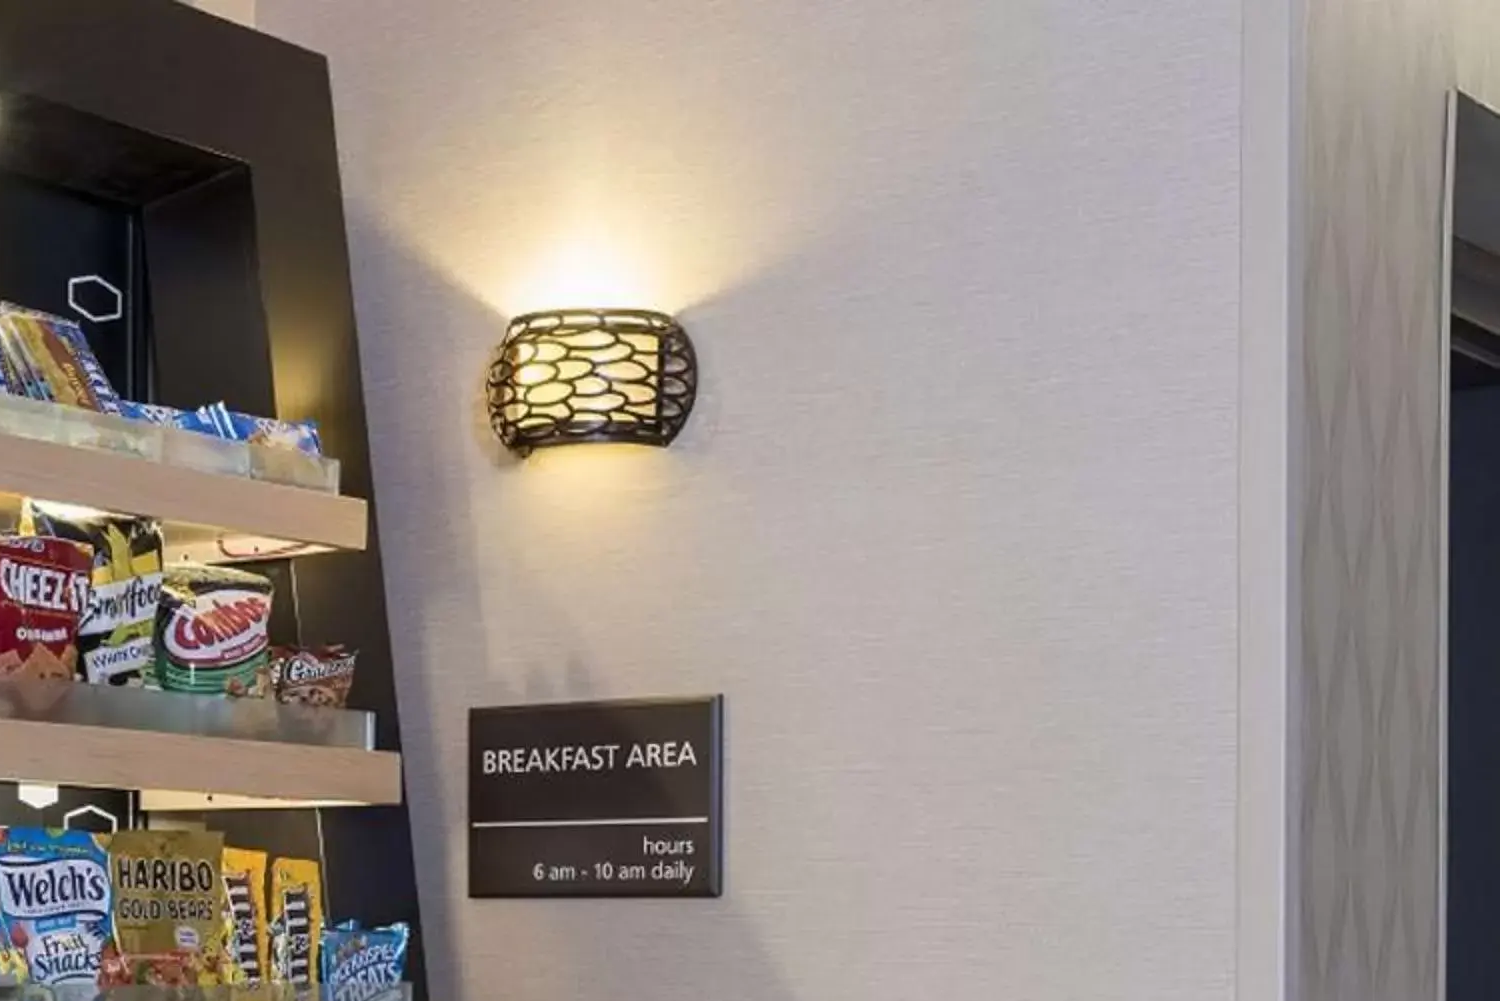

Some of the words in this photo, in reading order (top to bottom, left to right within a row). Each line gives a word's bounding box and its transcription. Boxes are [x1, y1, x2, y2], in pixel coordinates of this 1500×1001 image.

[482, 744, 620, 774] BREAKFAST
[626, 741, 697, 768] AREA
[642, 835, 695, 855] hours
[117, 858, 215, 893] HARIBO
[533, 862, 544, 880] 6
[548, 866, 575, 880] am
[594, 862, 613, 880] 10
[618, 865, 645, 880] am
[651, 860, 695, 884] daily
[3, 865, 106, 908] Welch's
[119, 898, 163, 920] GOLD
[166, 898, 214, 922] BEARS
[41, 933, 89, 957] Fruit
